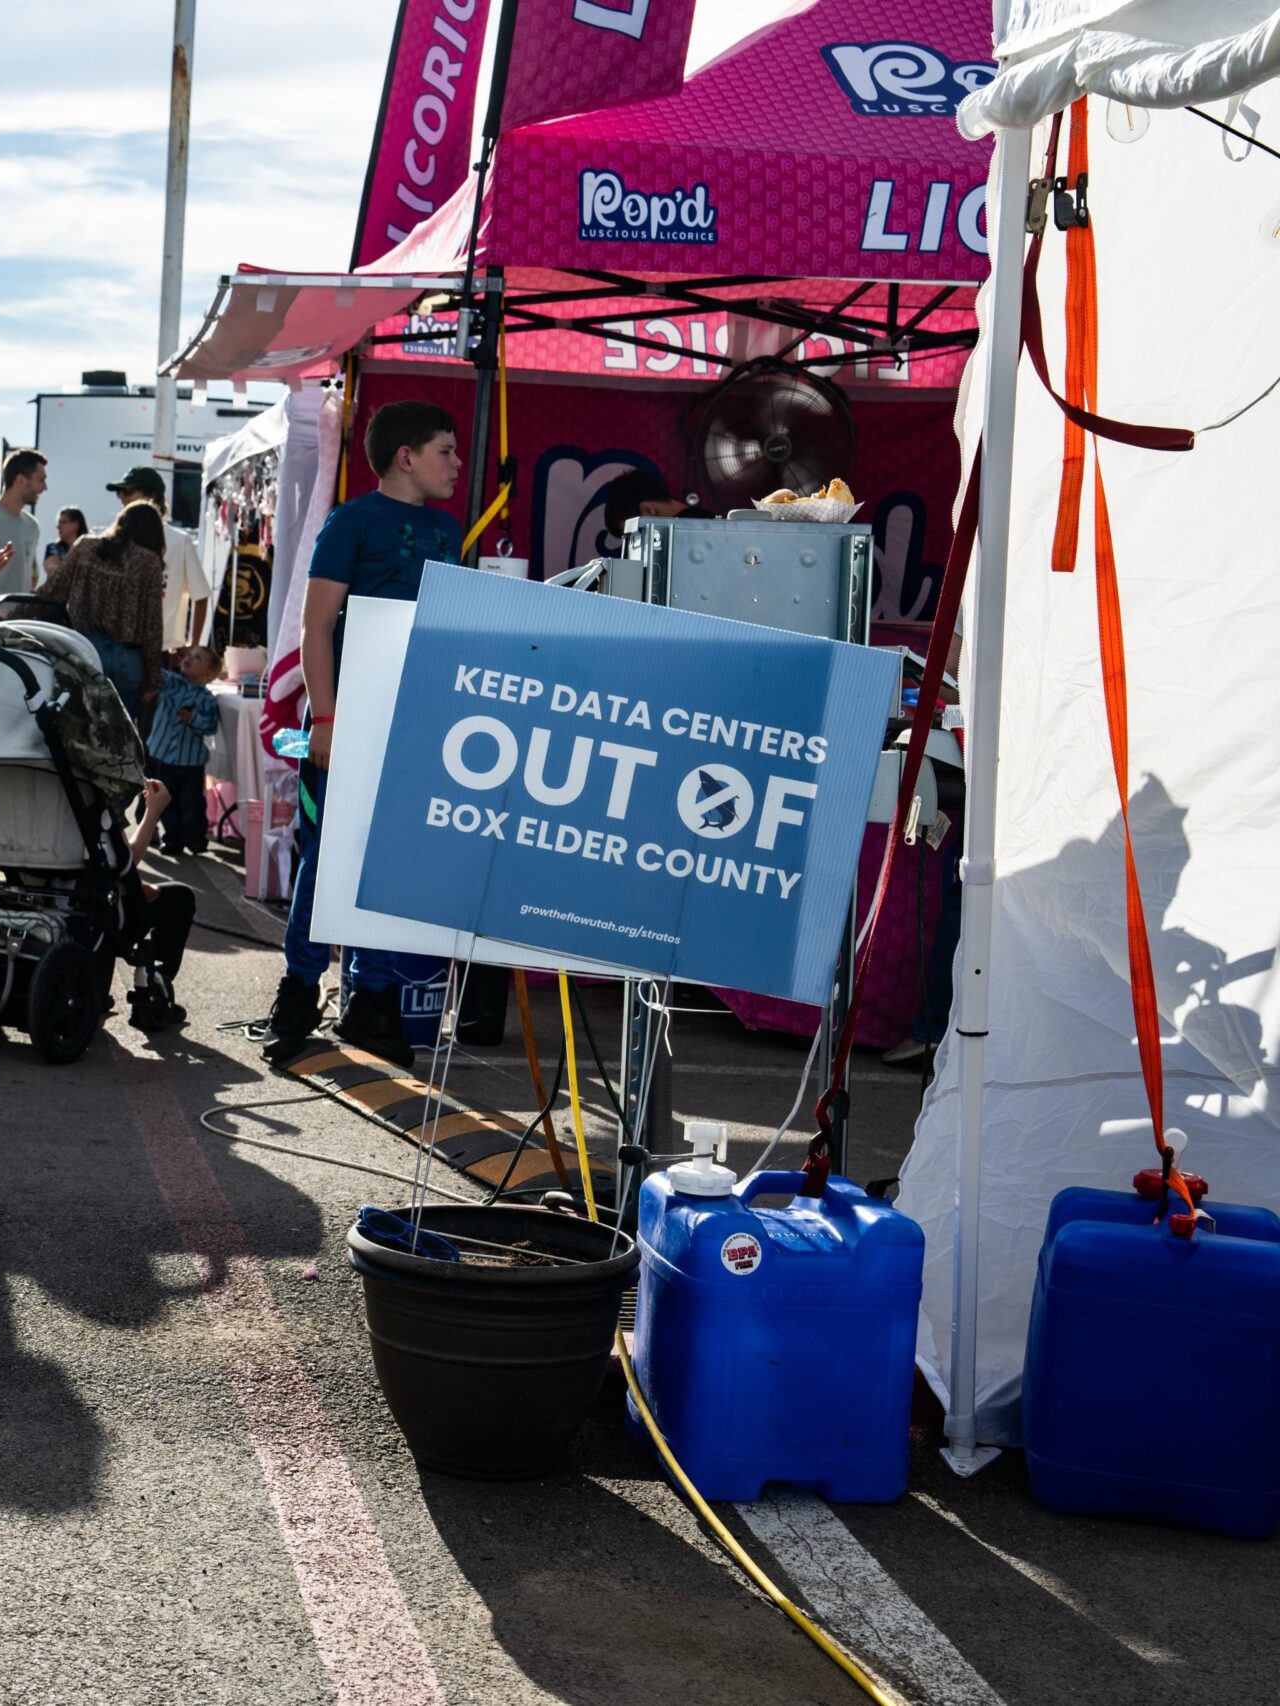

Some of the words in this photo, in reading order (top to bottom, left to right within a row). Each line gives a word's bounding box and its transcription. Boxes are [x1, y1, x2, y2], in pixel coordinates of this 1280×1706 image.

[862, 104, 958, 113] LUSC
[582, 228, 647, 238] LUSCIOUS
[660, 231, 714, 241] LICORICE
[109, 440, 153, 451] FORE
[176, 444, 206, 453] RIV
[455, 665, 543, 704] KEEP
[551, 685, 650, 729] DATA
[663, 709, 828, 763] CENTERS
[443, 716, 657, 820] OUT
[678, 764, 818, 850] OF
[427, 798, 509, 839] BOX
[517, 817, 627, 865] ELDER
[637, 844, 802, 899] COUNTY
[520, 905, 681, 945] growtheflowutah.org/stratos
[727, 1245, 757, 1262] BPA
